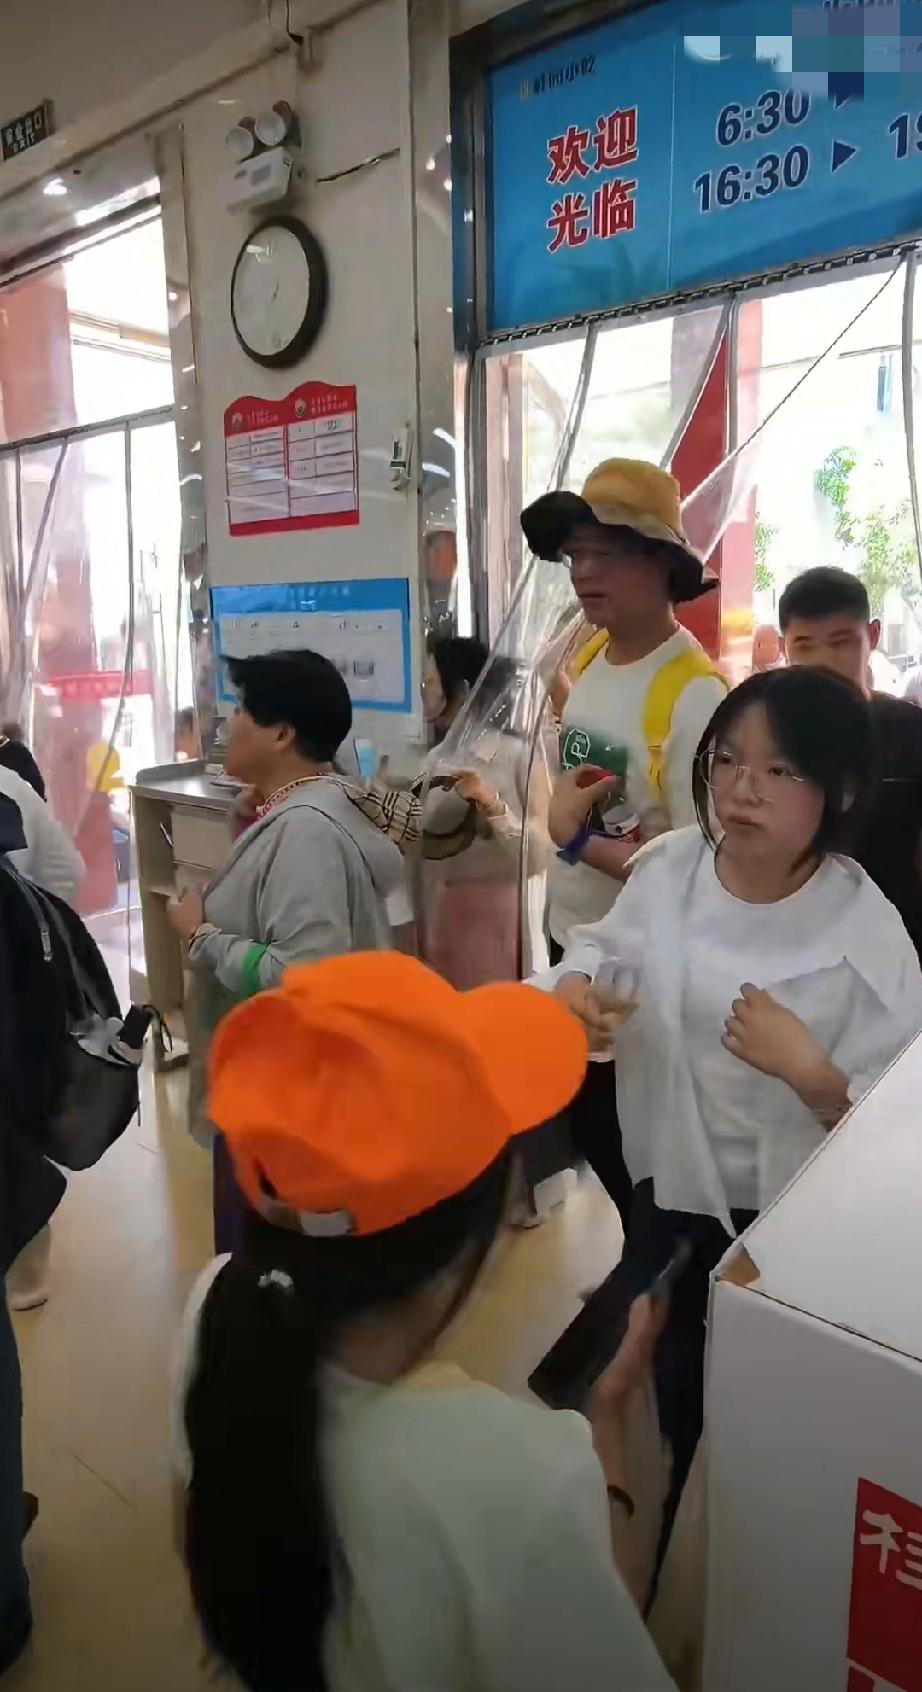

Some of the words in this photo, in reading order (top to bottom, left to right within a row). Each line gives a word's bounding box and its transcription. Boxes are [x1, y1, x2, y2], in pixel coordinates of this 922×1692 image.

[547, 105, 639, 184] 欢迎
[716, 90, 811, 147] 6:30
[694, 144, 809, 213] 16:30
[547, 178, 638, 253] 光临
